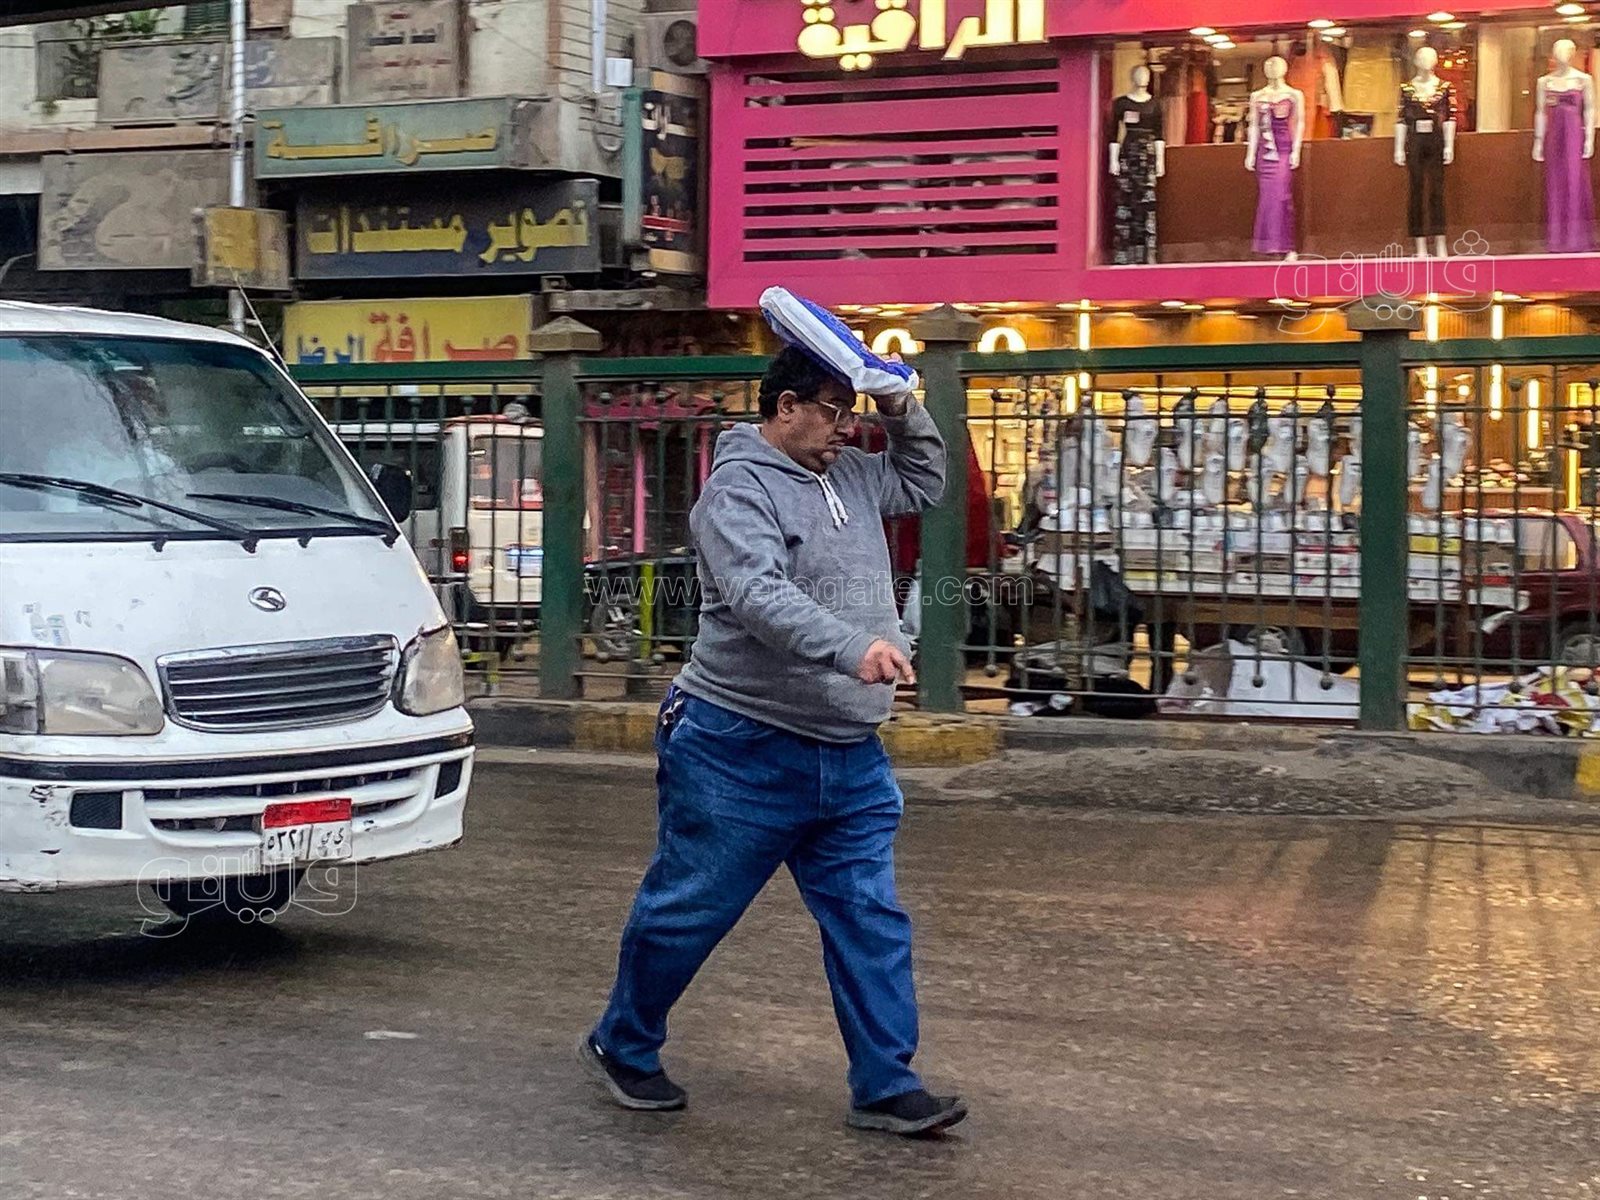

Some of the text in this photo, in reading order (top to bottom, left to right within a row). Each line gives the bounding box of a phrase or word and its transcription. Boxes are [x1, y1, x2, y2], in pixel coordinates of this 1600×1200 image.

[798, 0, 1048, 71] الراقية
[262, 112, 497, 166] صرافة
[307, 205, 467, 254] مستندات
[479, 199, 589, 263] تصوير
[369, 311, 519, 362] صرافة
